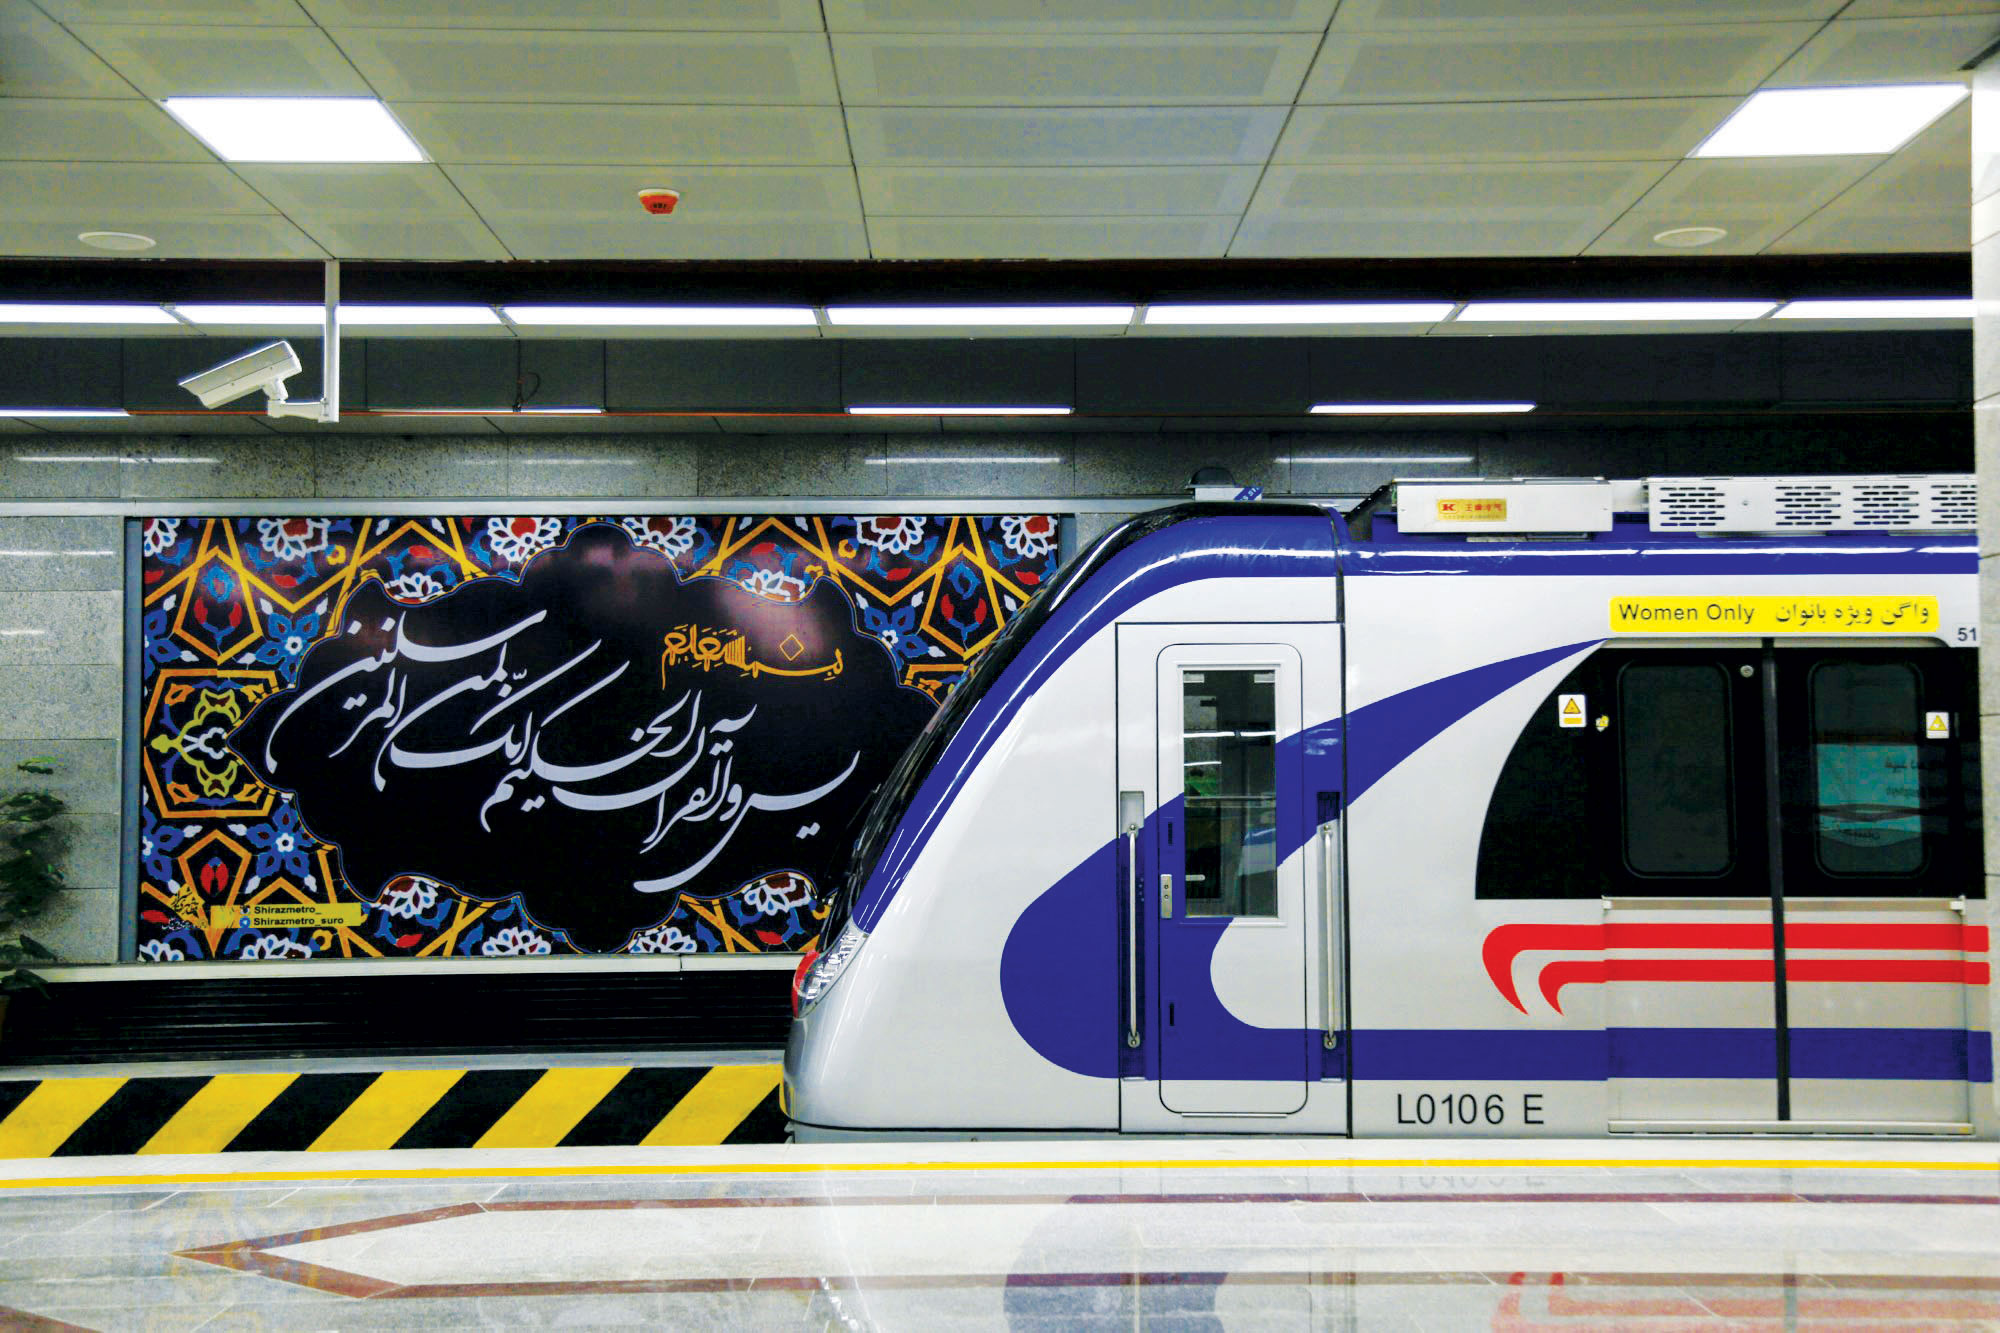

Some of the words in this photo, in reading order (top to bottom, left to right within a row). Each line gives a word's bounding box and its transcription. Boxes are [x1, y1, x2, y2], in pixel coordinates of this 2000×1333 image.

[1619, 603, 1698, 620] Women
[1706, 603, 1755, 625] Only
[1775, 603, 1827, 627] بانوان
[1834, 604, 1873, 627] ویژه
[1880, 601, 1930, 626] واگن
[1957, 627, 1977, 642] 51
[1397, 1093, 1505, 1125] L0106
[1523, 1093, 1545, 1125] E
